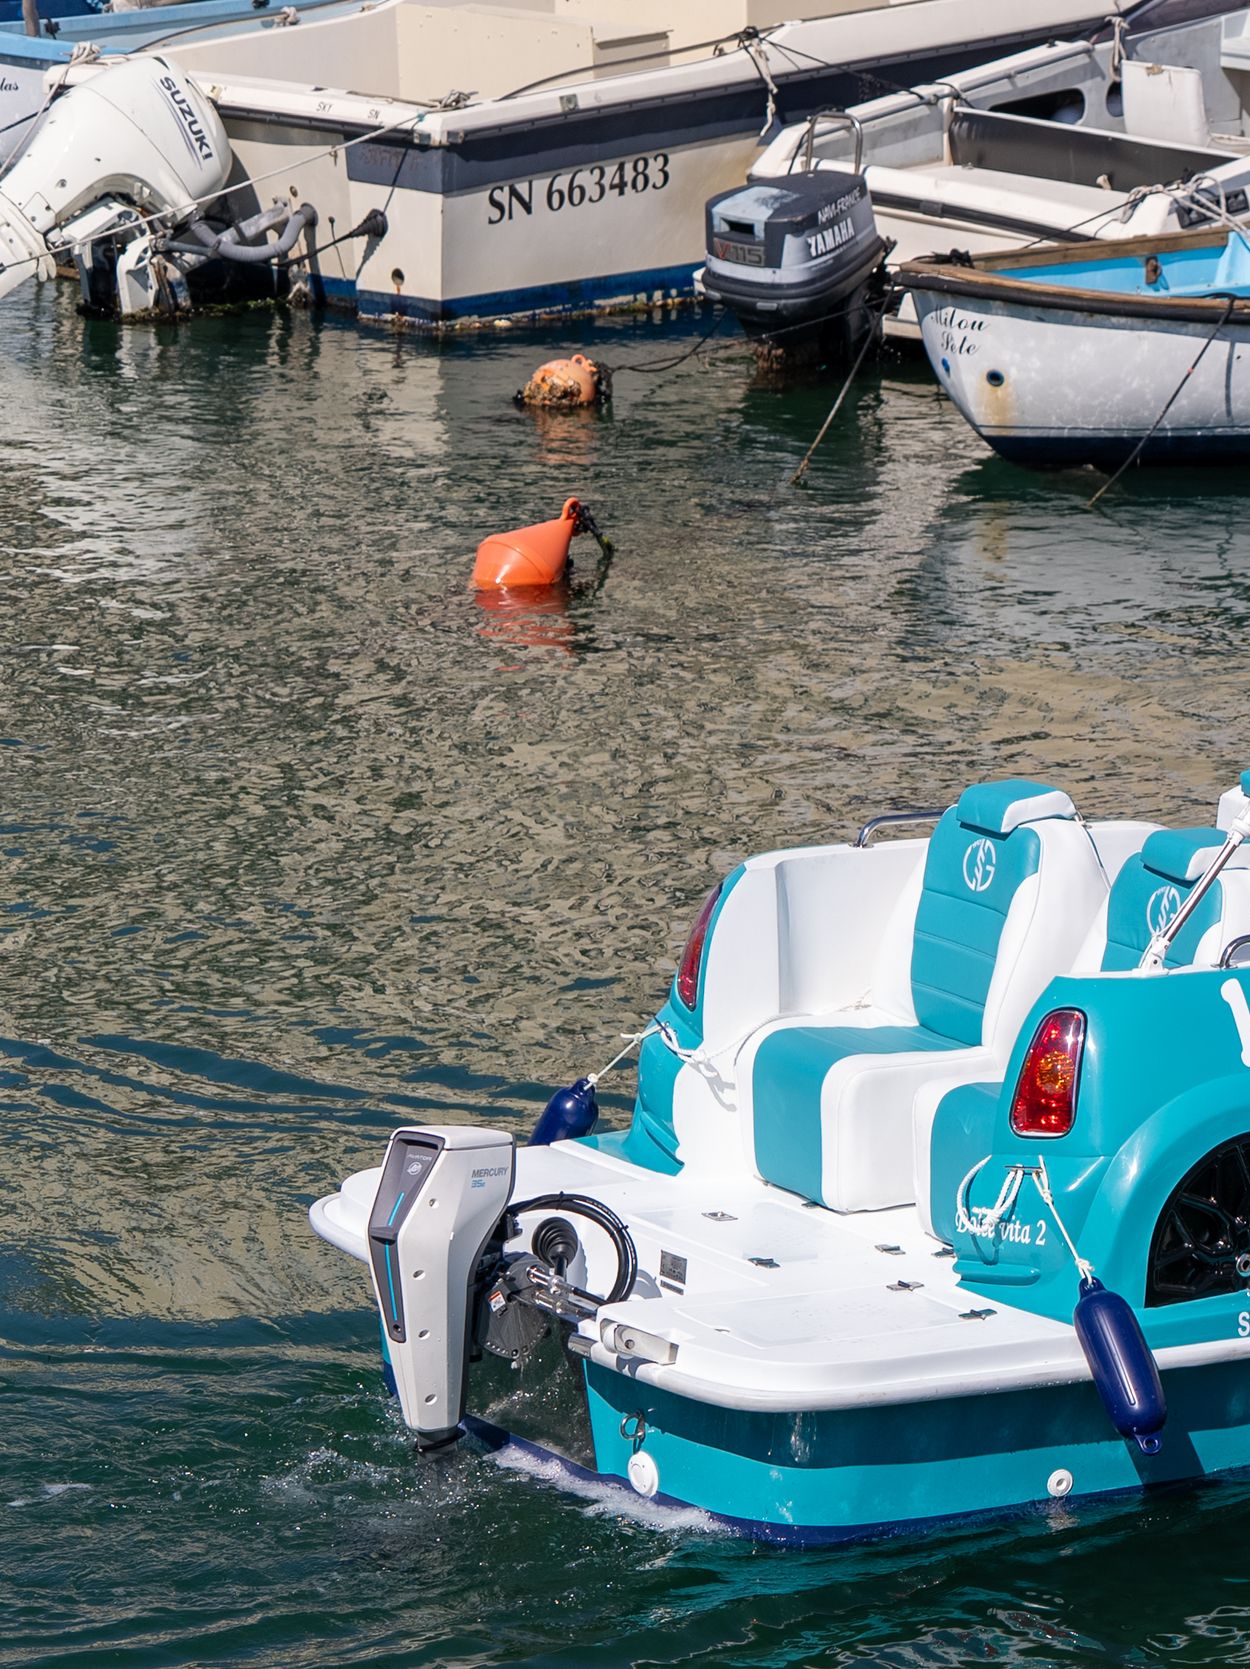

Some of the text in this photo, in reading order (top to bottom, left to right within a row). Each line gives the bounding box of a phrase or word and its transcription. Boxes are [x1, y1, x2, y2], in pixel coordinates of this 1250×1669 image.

[159, 75, 213, 161] SUZUKI
[487, 152, 670, 226] SN 663483
[806, 217, 856, 257] YAMAHA
[471, 1166, 509, 1179] MERCURY
[998, 1214, 1032, 1245] vita
[1035, 1219, 1047, 1246] 2
